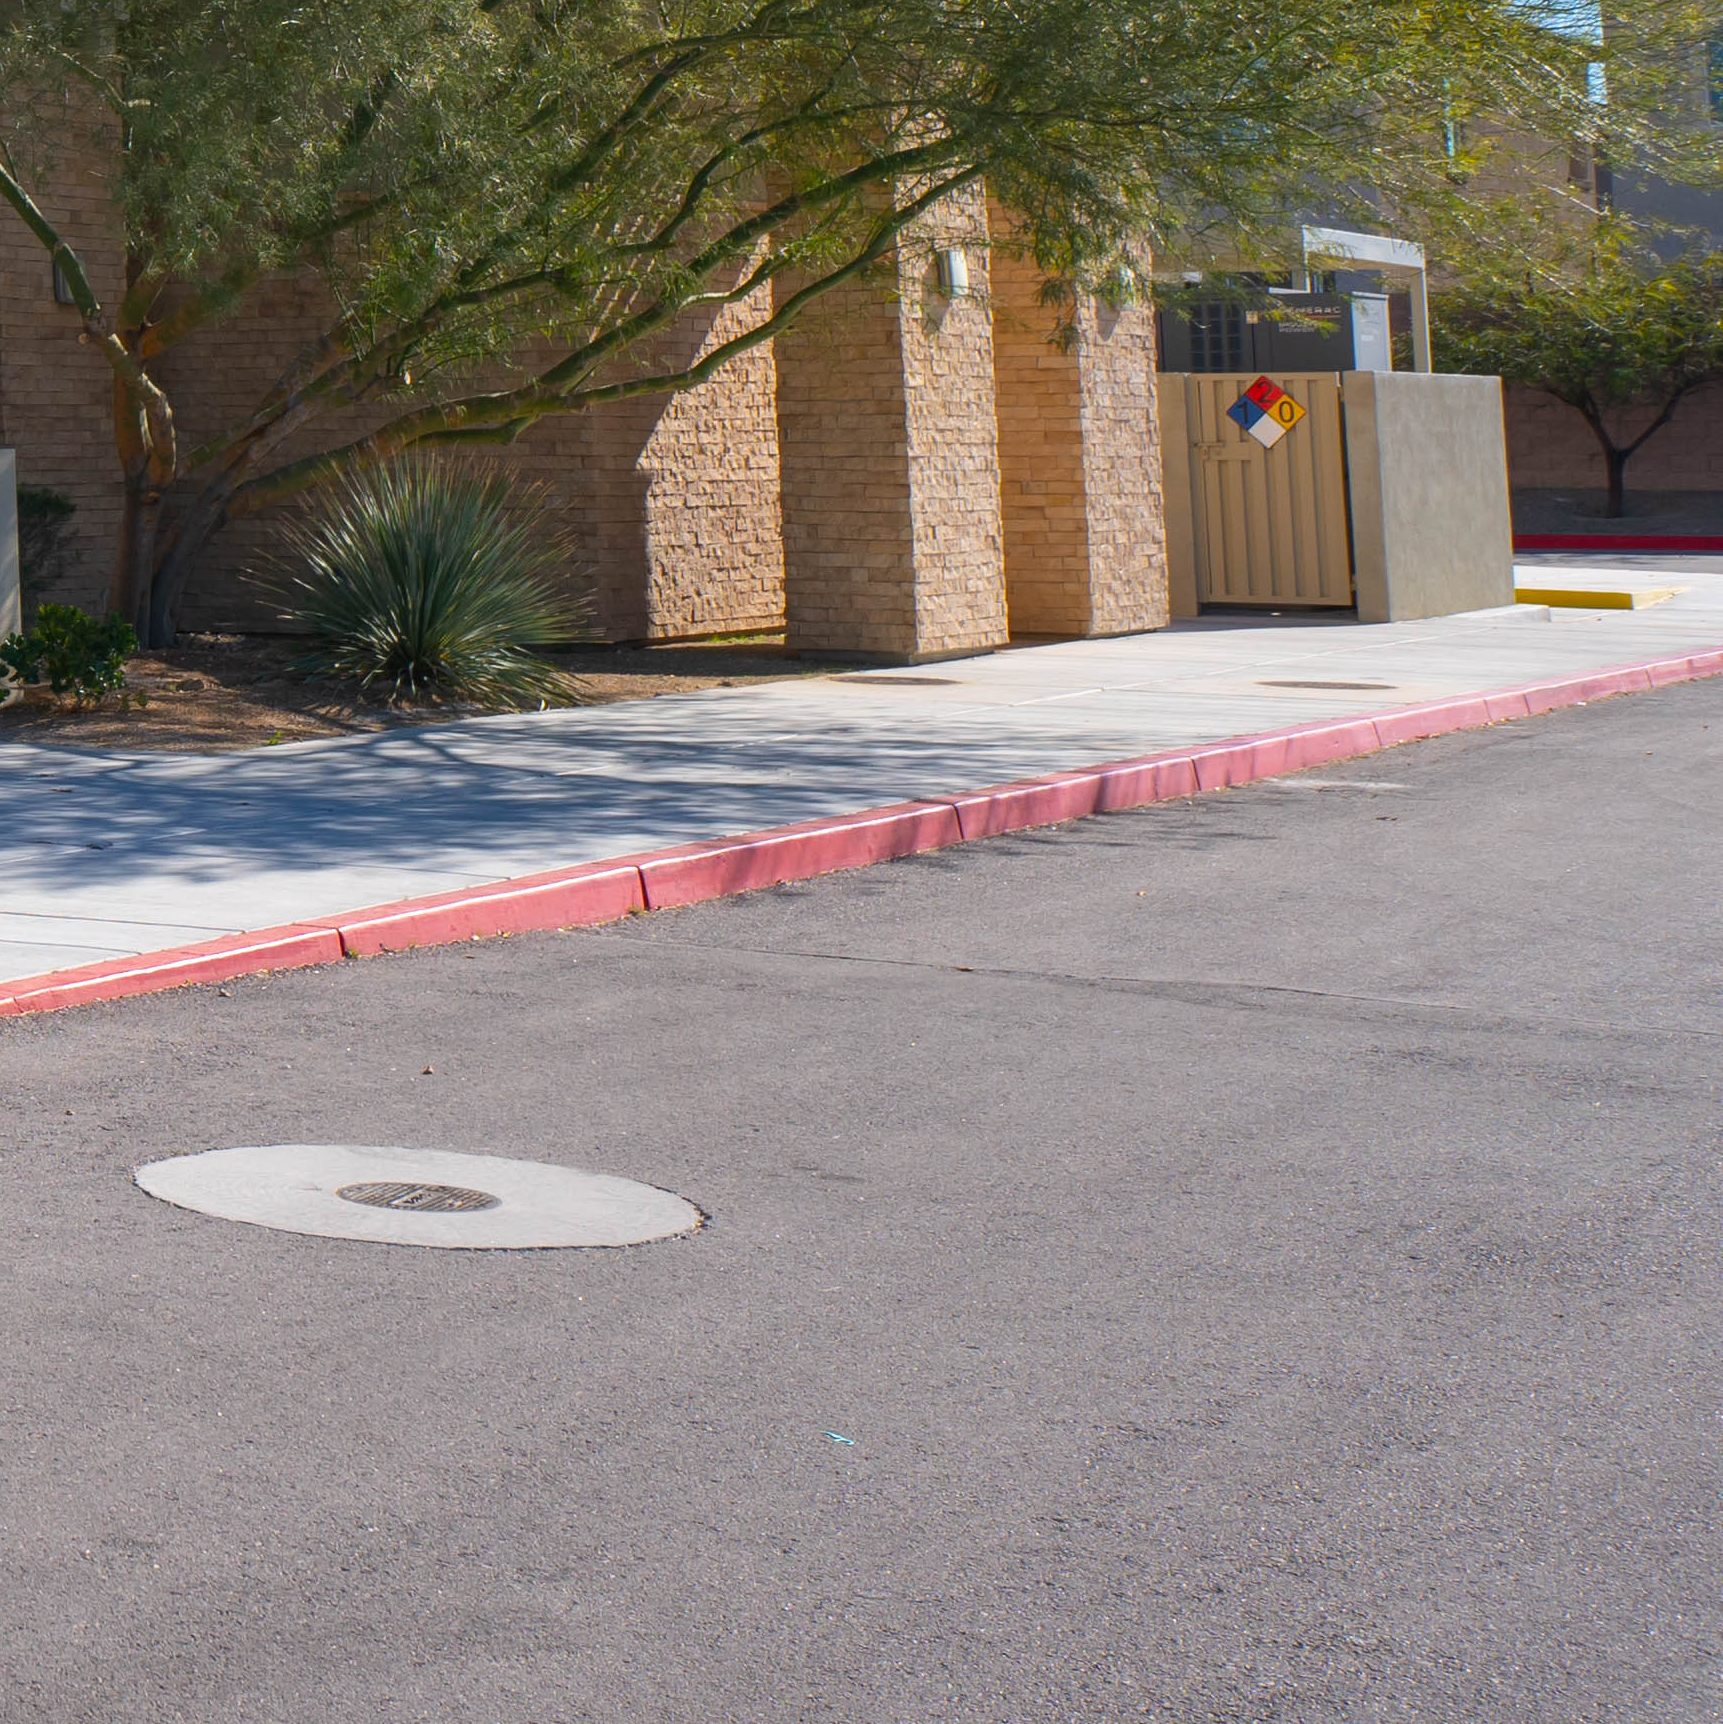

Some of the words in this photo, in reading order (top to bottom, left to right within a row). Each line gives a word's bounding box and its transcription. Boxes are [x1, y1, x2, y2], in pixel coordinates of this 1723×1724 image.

[1258, 380, 1276, 403] 2
[1237, 401, 1249, 424] 1
[1279, 401, 1294, 423] 0
